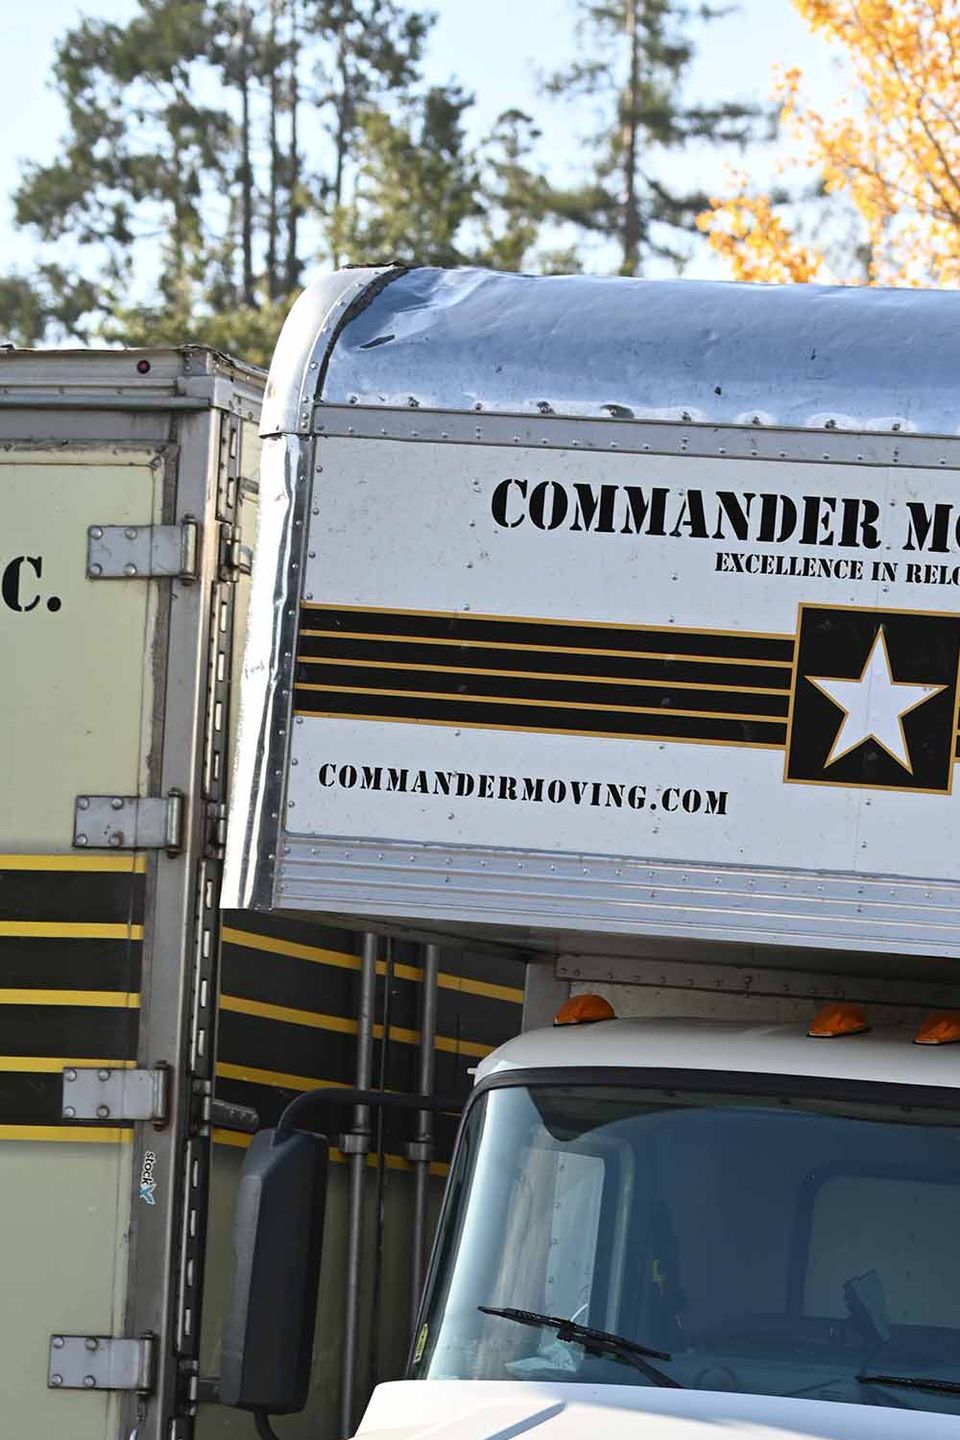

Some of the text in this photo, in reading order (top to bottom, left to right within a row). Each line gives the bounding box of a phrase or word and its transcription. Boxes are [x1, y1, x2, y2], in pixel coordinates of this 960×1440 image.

[491, 477, 882, 550] COMMANDER
[714, 552, 864, 581] EXCELLENCE
[871, 561, 898, 583] IN
[318, 762, 729, 816] COMMANDERMOVING.COM
